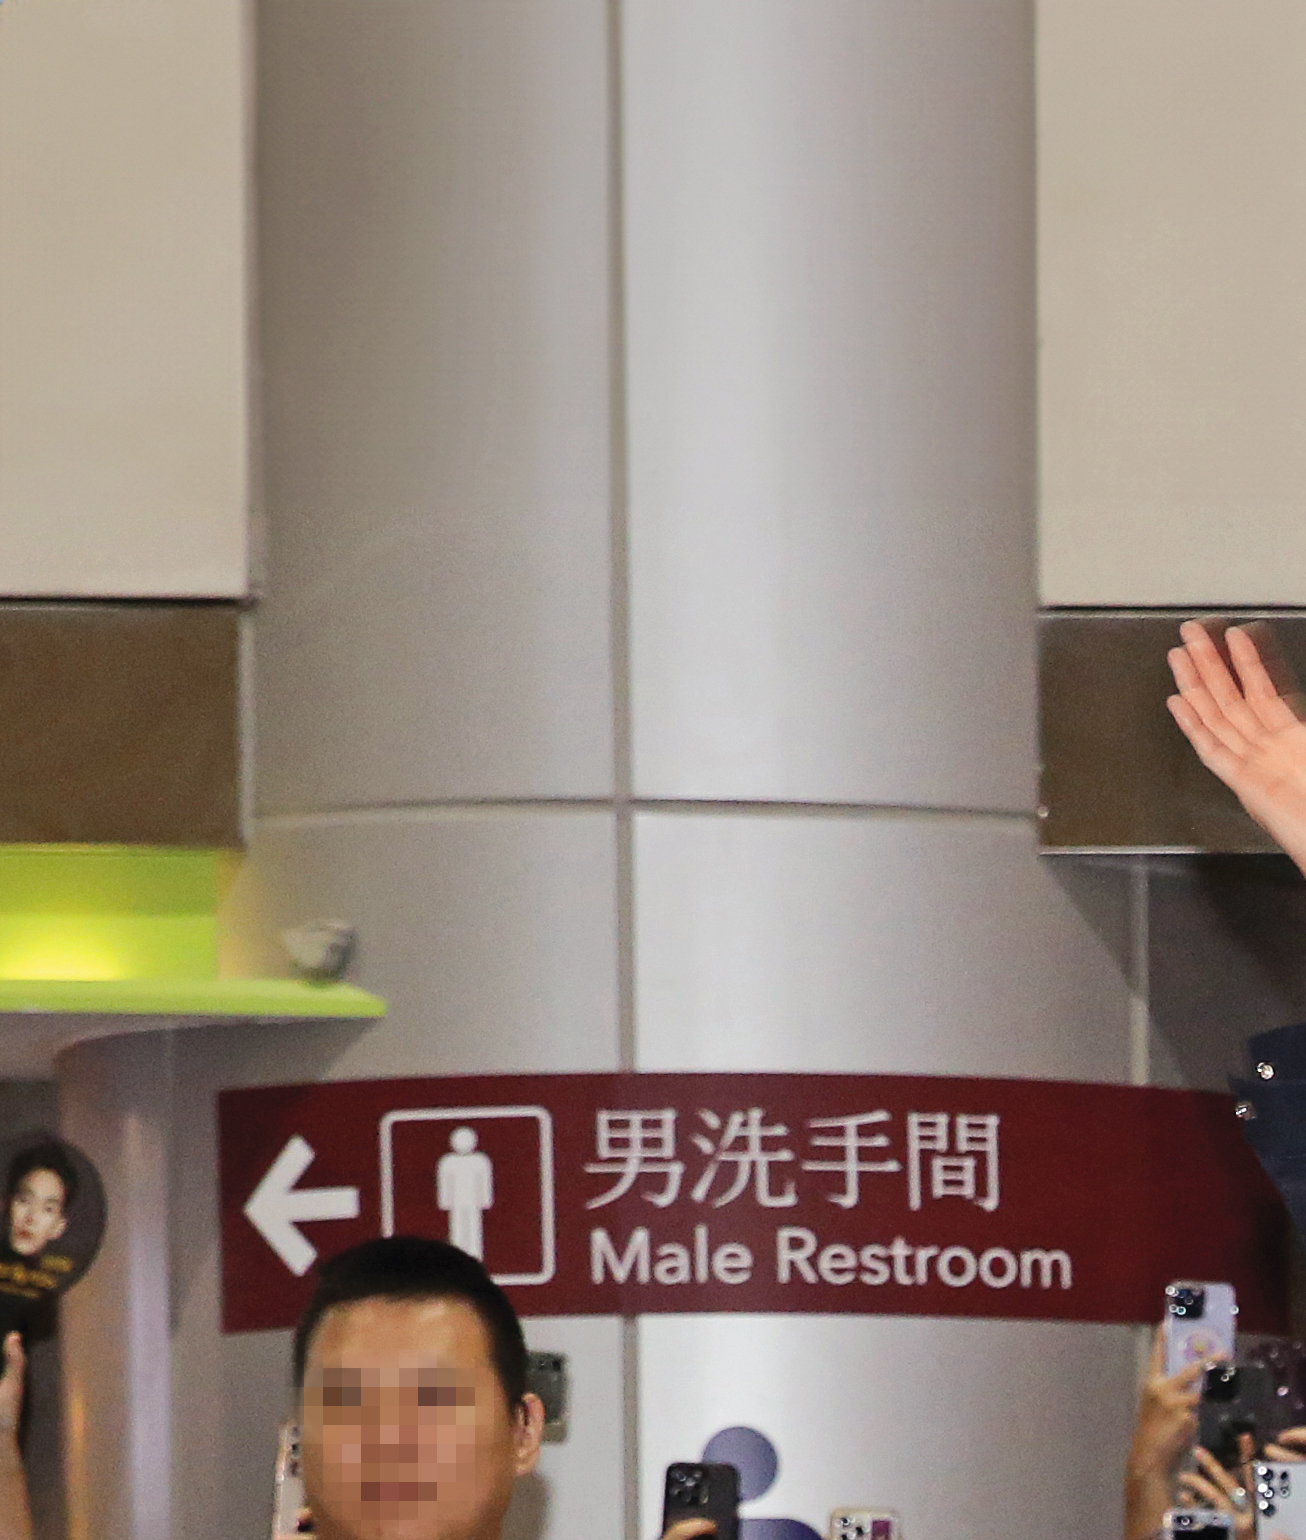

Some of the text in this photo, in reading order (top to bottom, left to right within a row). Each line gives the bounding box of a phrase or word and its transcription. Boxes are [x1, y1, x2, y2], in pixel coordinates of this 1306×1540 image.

[583, 1106, 1000, 1212] 男洗手間
[589, 1223, 1074, 1290] Male Restroom
